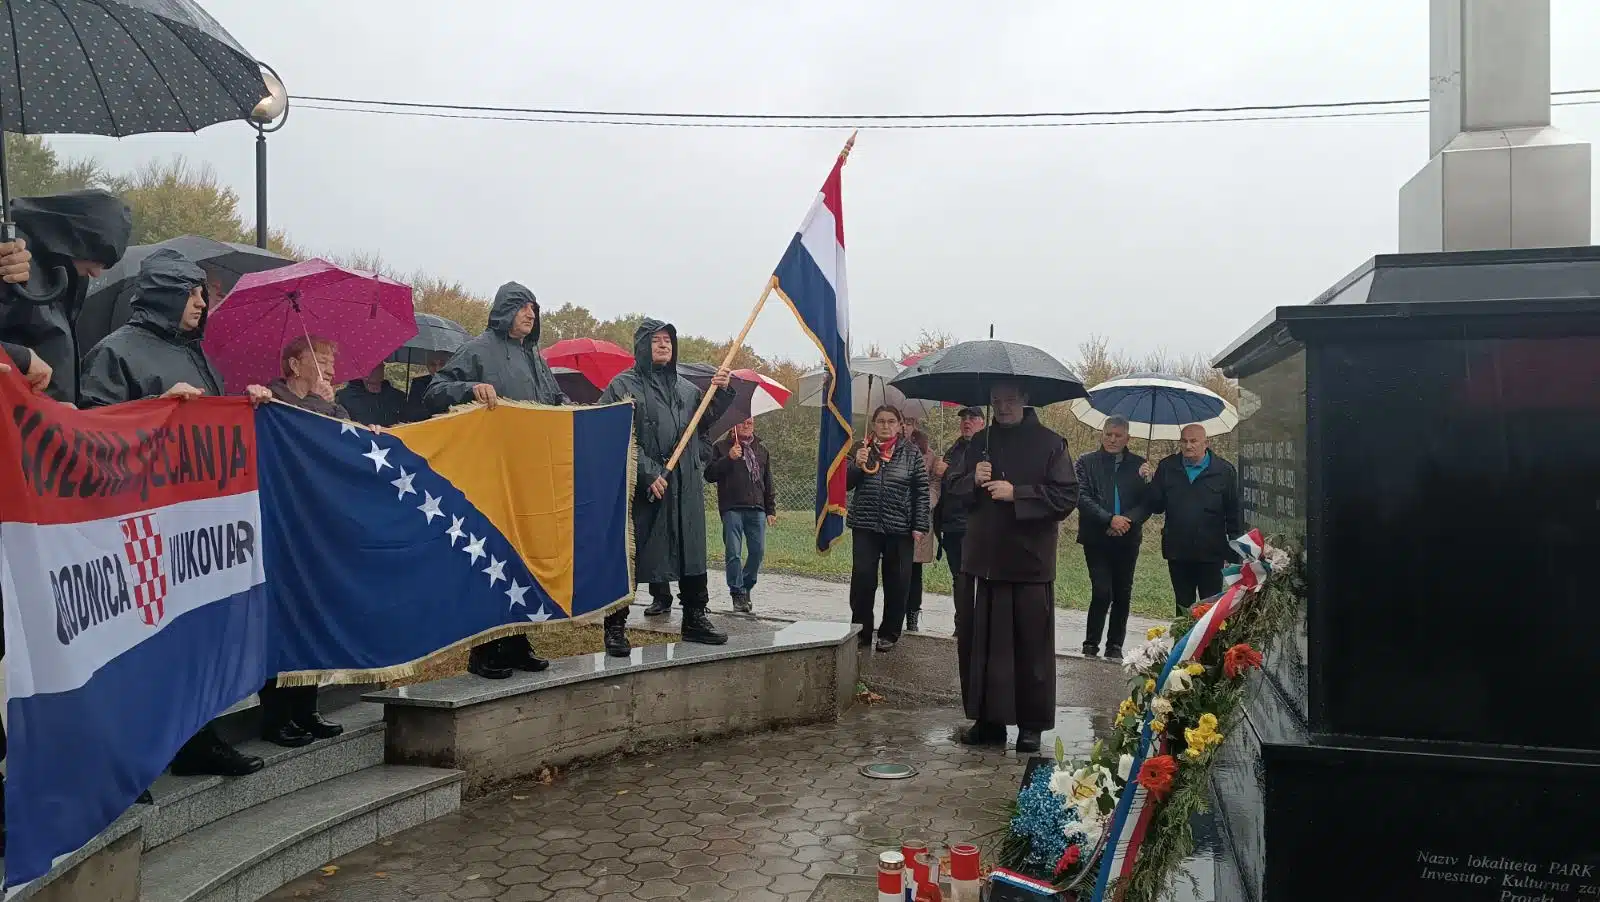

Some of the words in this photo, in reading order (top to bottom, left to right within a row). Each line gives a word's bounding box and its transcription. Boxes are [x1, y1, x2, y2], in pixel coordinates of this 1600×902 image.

[168, 520, 256, 586] VUKOVAR
[1417, 851, 1459, 865] Naziv
[1548, 862, 1595, 877] PARK
[1501, 874, 1570, 892] Kulturna
